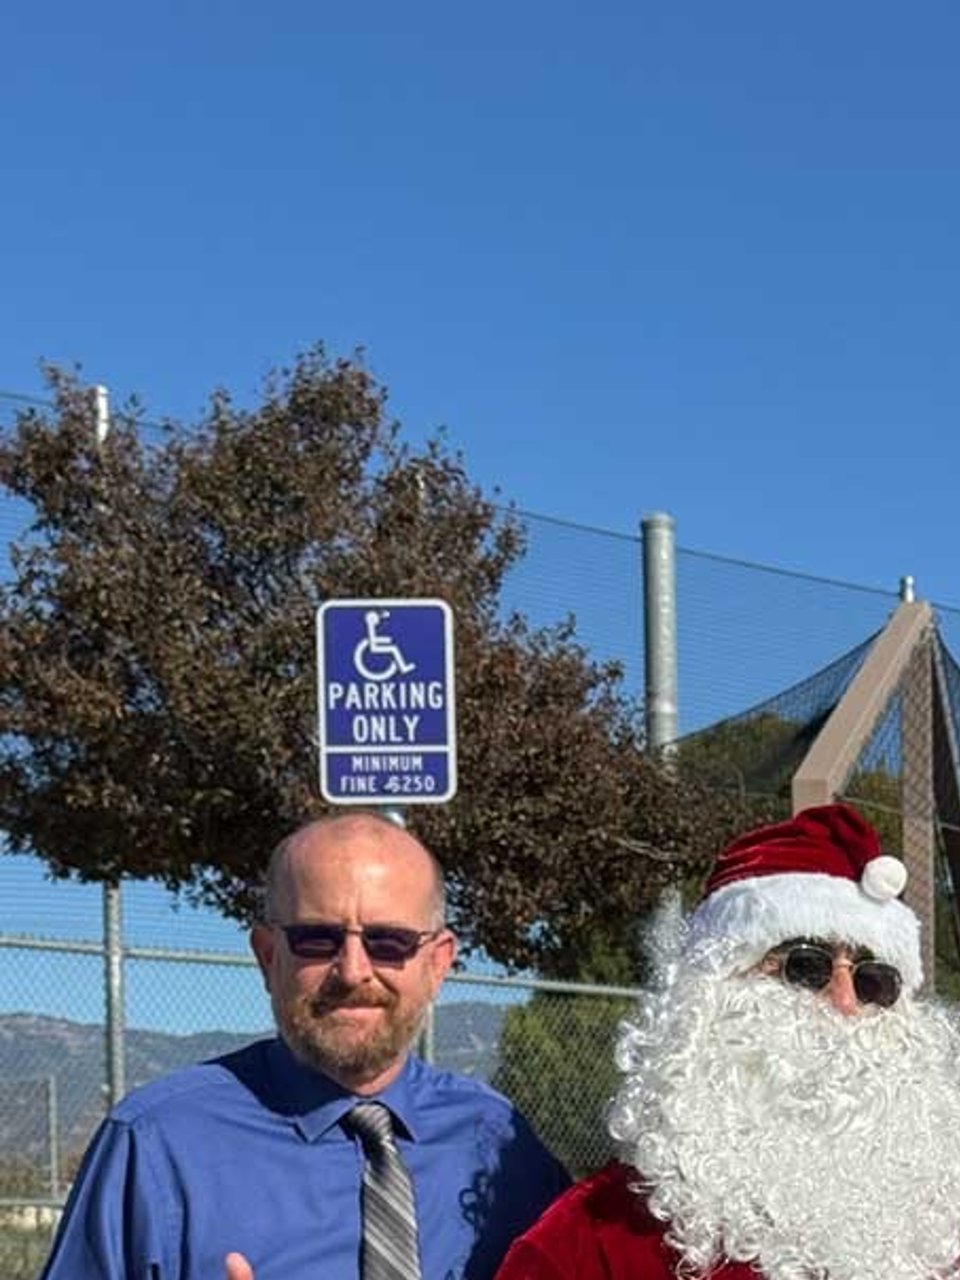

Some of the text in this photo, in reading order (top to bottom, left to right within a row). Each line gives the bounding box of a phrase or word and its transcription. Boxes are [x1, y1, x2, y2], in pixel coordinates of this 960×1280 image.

[328, 682, 443, 710] PARKING
[352, 714, 420, 742] ONLY
[351, 755, 423, 772] MINIMUM
[340, 775, 376, 793] FINE
